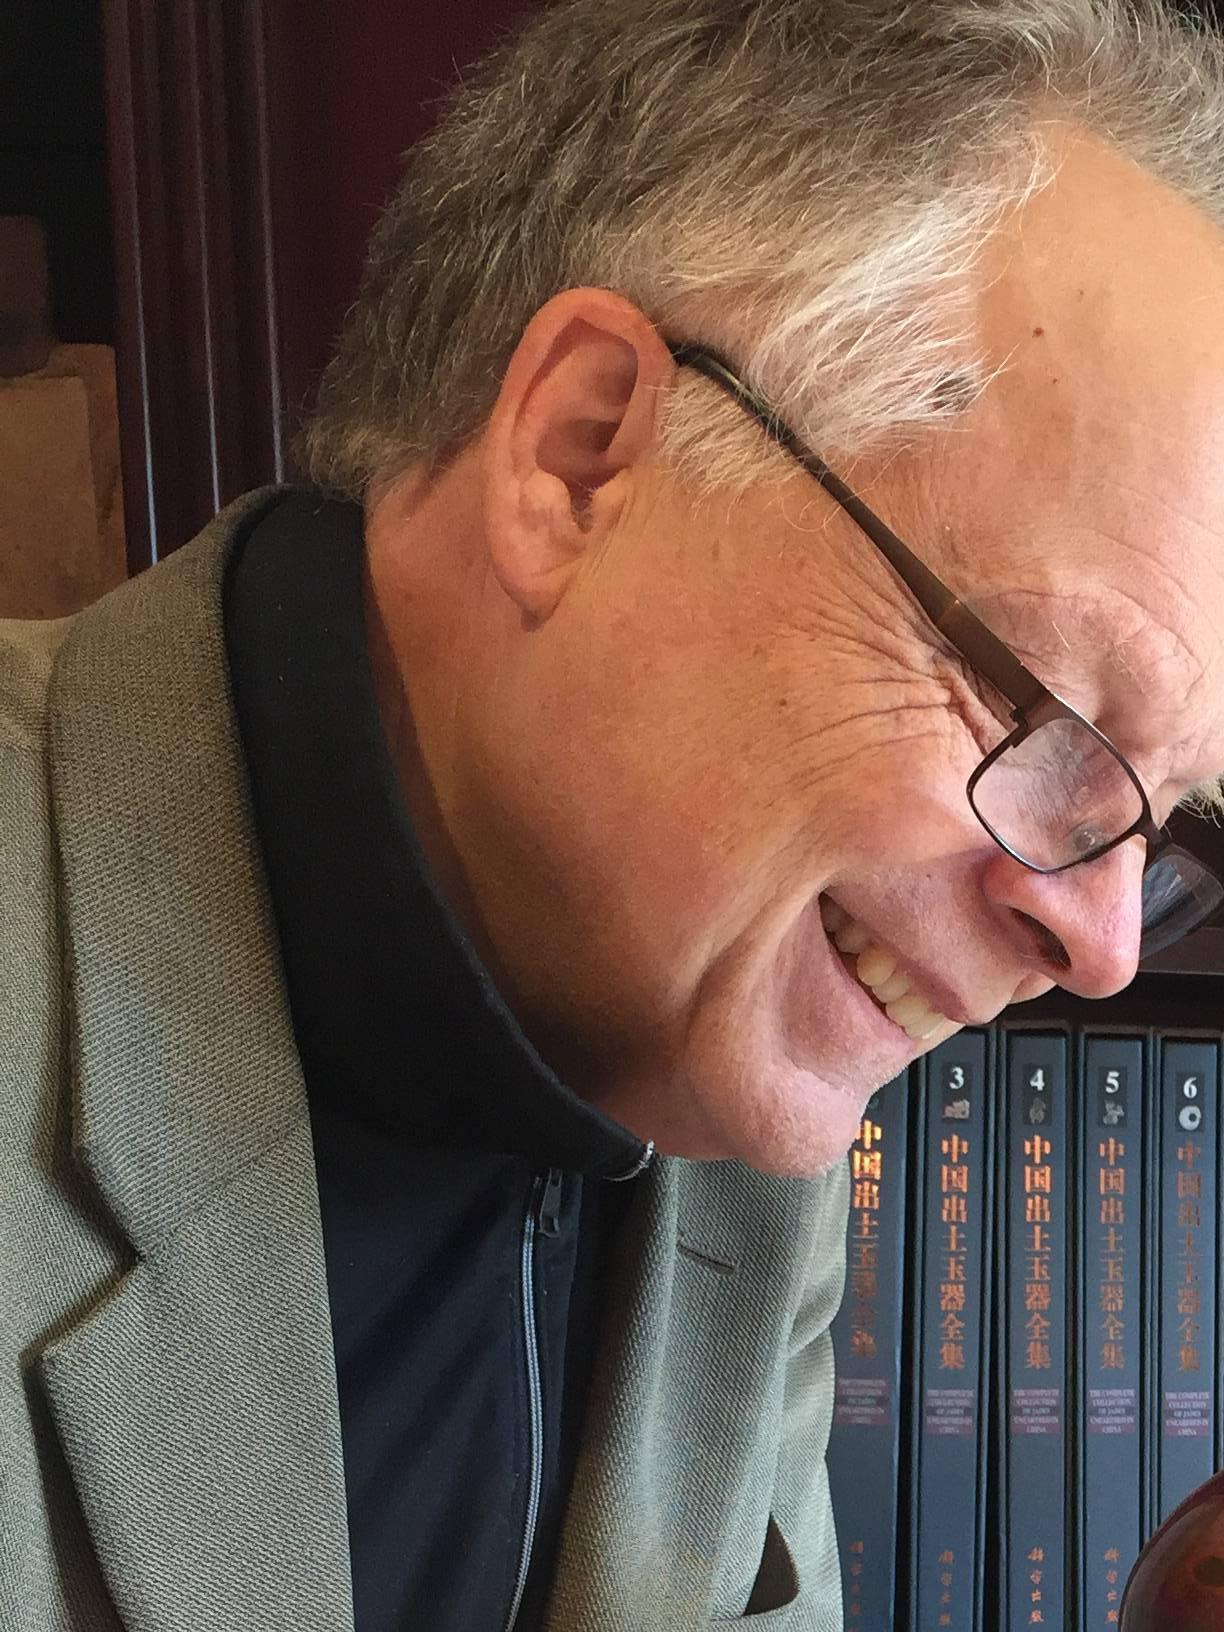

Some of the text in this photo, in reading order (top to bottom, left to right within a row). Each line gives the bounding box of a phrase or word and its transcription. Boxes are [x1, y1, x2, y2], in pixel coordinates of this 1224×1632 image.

[950, 1067, 965, 1090] 3
[1029, 1068, 1045, 1091] 4
[1105, 1071, 1119, 1093] 5
[1183, 1077, 1198, 1099] 6
[940, 1134, 968, 1369] 中国出土玉器全集
[1024, 1134, 1052, 1369] 中国出土玉器全集
[1099, 1137, 1125, 1369] 中国出土玉器全集
[1177, 1141, 1201, 1371] 中国出土玉器全集
